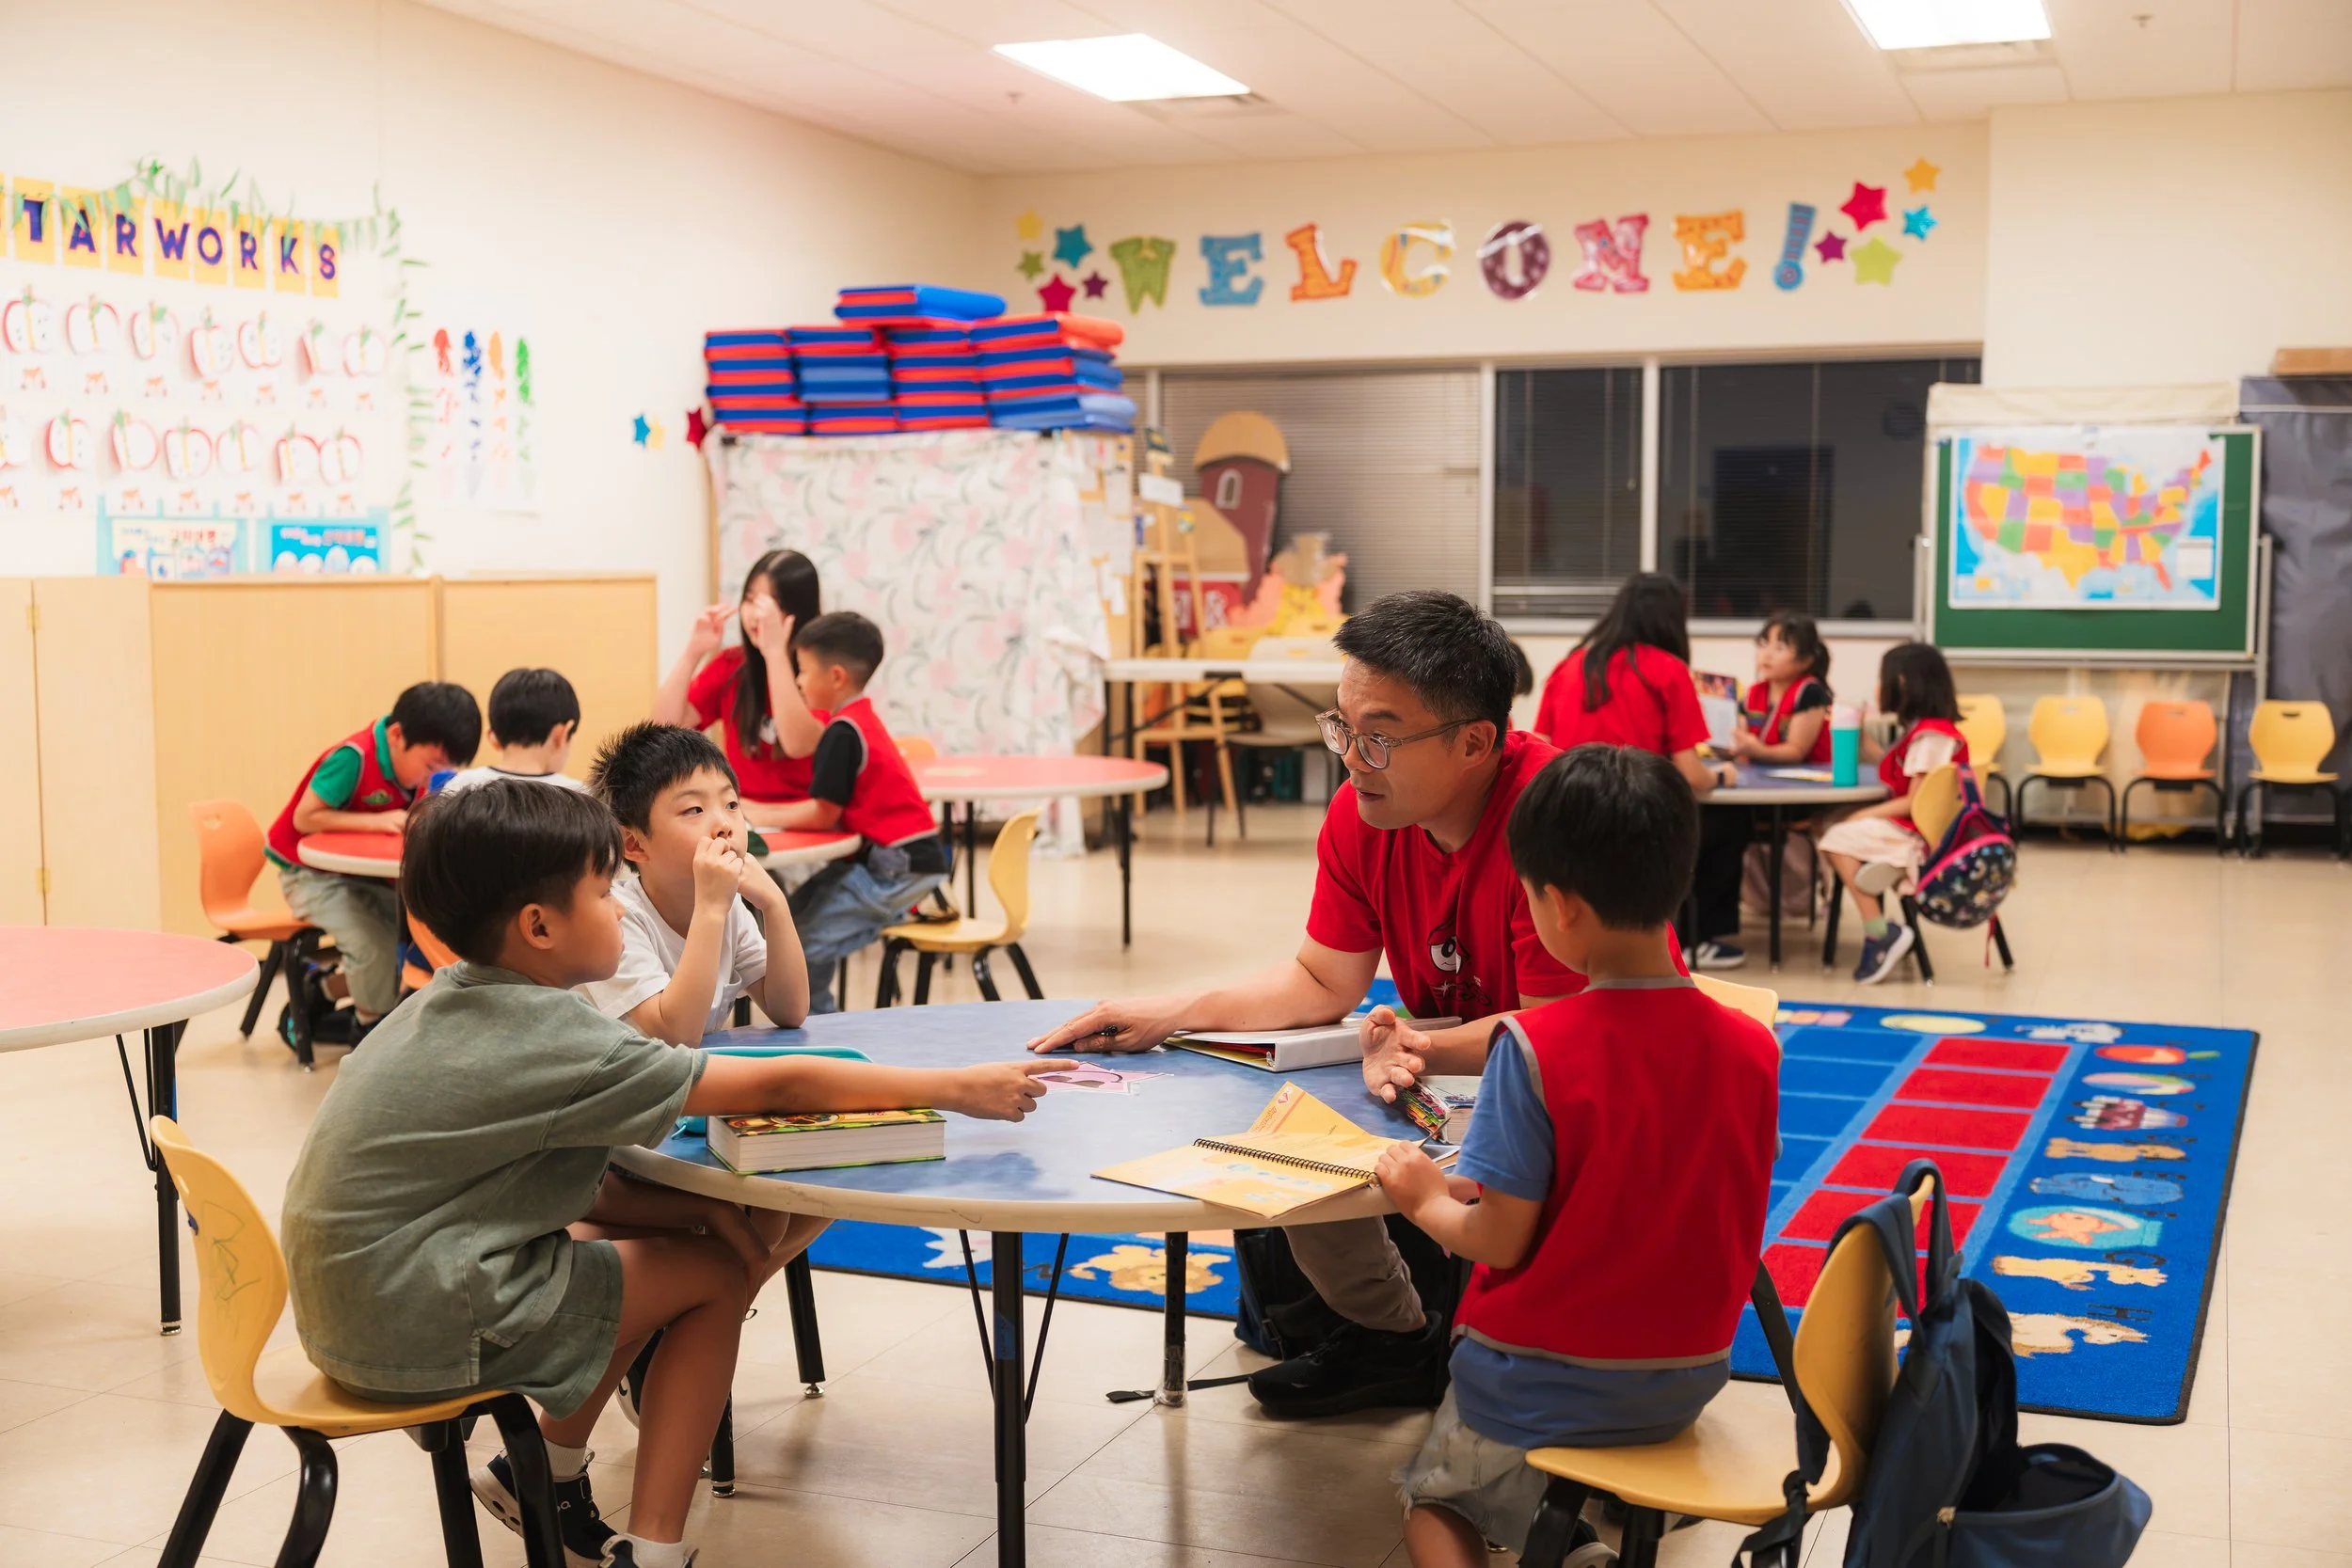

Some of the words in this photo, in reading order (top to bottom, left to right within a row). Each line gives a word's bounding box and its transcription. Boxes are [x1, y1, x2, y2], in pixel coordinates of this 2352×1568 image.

[0, 198, 336, 280] TARWORKS
[2104, 1248, 2168, 1266] G
[2086, 1304, 2153, 1323] H
